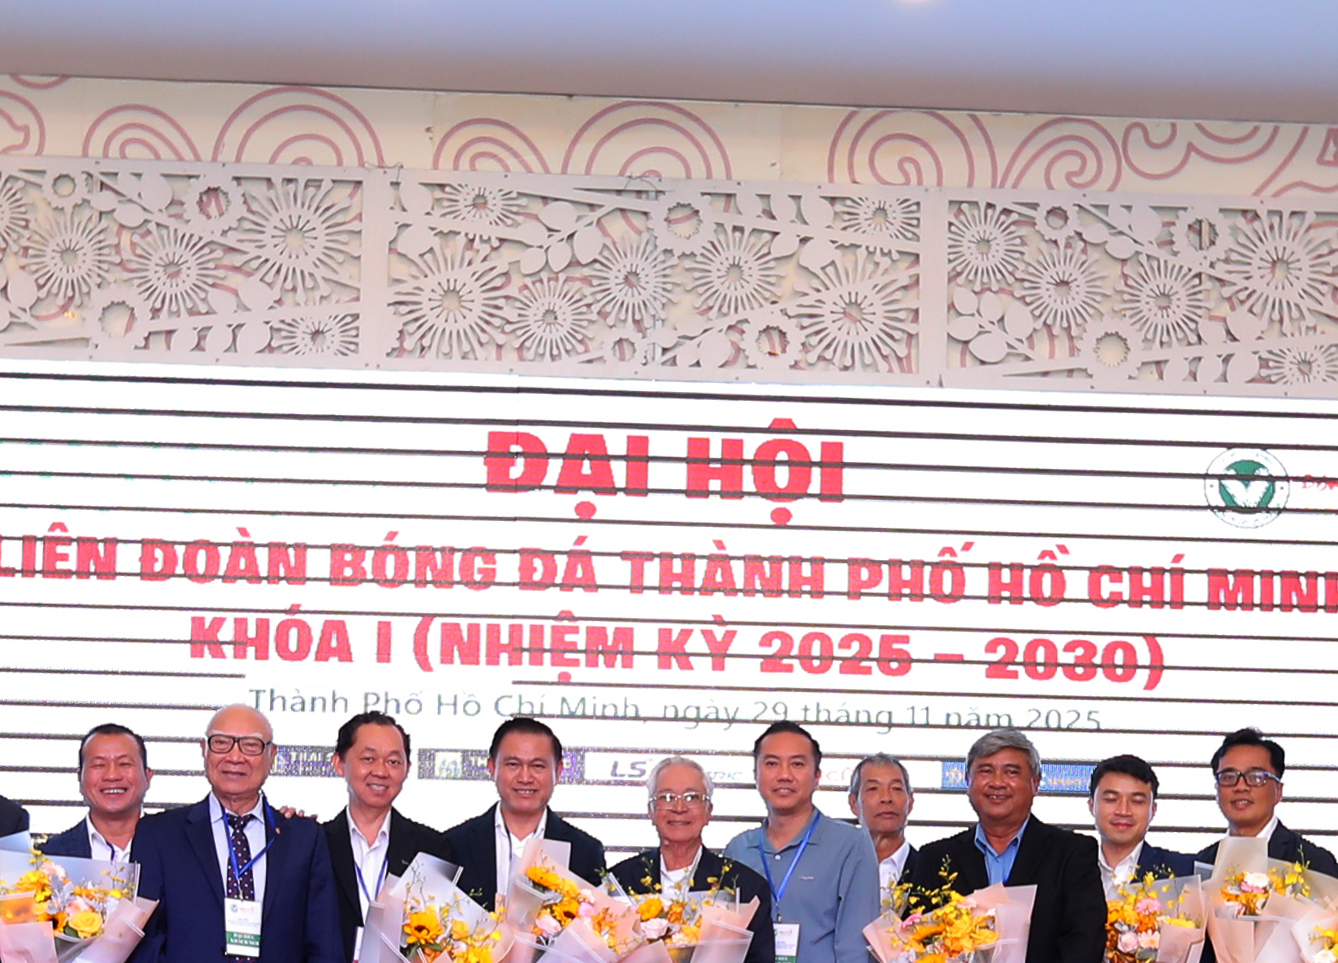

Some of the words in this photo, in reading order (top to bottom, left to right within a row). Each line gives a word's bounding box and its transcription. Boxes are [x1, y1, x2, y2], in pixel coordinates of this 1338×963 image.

[483, 431, 649, 519] ĐẠI
[686, 418, 844, 526] HỘI
[139, 527, 307, 585] ĐOÀN
[329, 531, 497, 590] BÓNG
[518, 535, 598, 592] ĐÁ
[621, 539, 825, 599] THÀNH
[847, 541, 975, 604] PHỐ
[987, 544, 1070, 608] HỒ
[1088, 554, 1185, 609] CHÍ
[190, 603, 353, 662] KHÓA
[376, 621, 392, 663] I
[413, 610, 634, 682] (NHIỆM
[658, 614, 738, 671] KỲ
[759, 631, 912, 677] 2025
[984, 635, 1164, 691] 2030)
[249, 688, 348, 713] Thành
[364, 690, 422, 715] Phố
[494, 694, 545, 717] Chí
[663, 699, 740, 731] ngày
[754, 701, 789, 722] 29
[801, 702, 893, 735] tháng
[906, 706, 930, 726] 11
[945, 707, 1012, 729] năm
[1027, 708, 1102, 732] 2025
